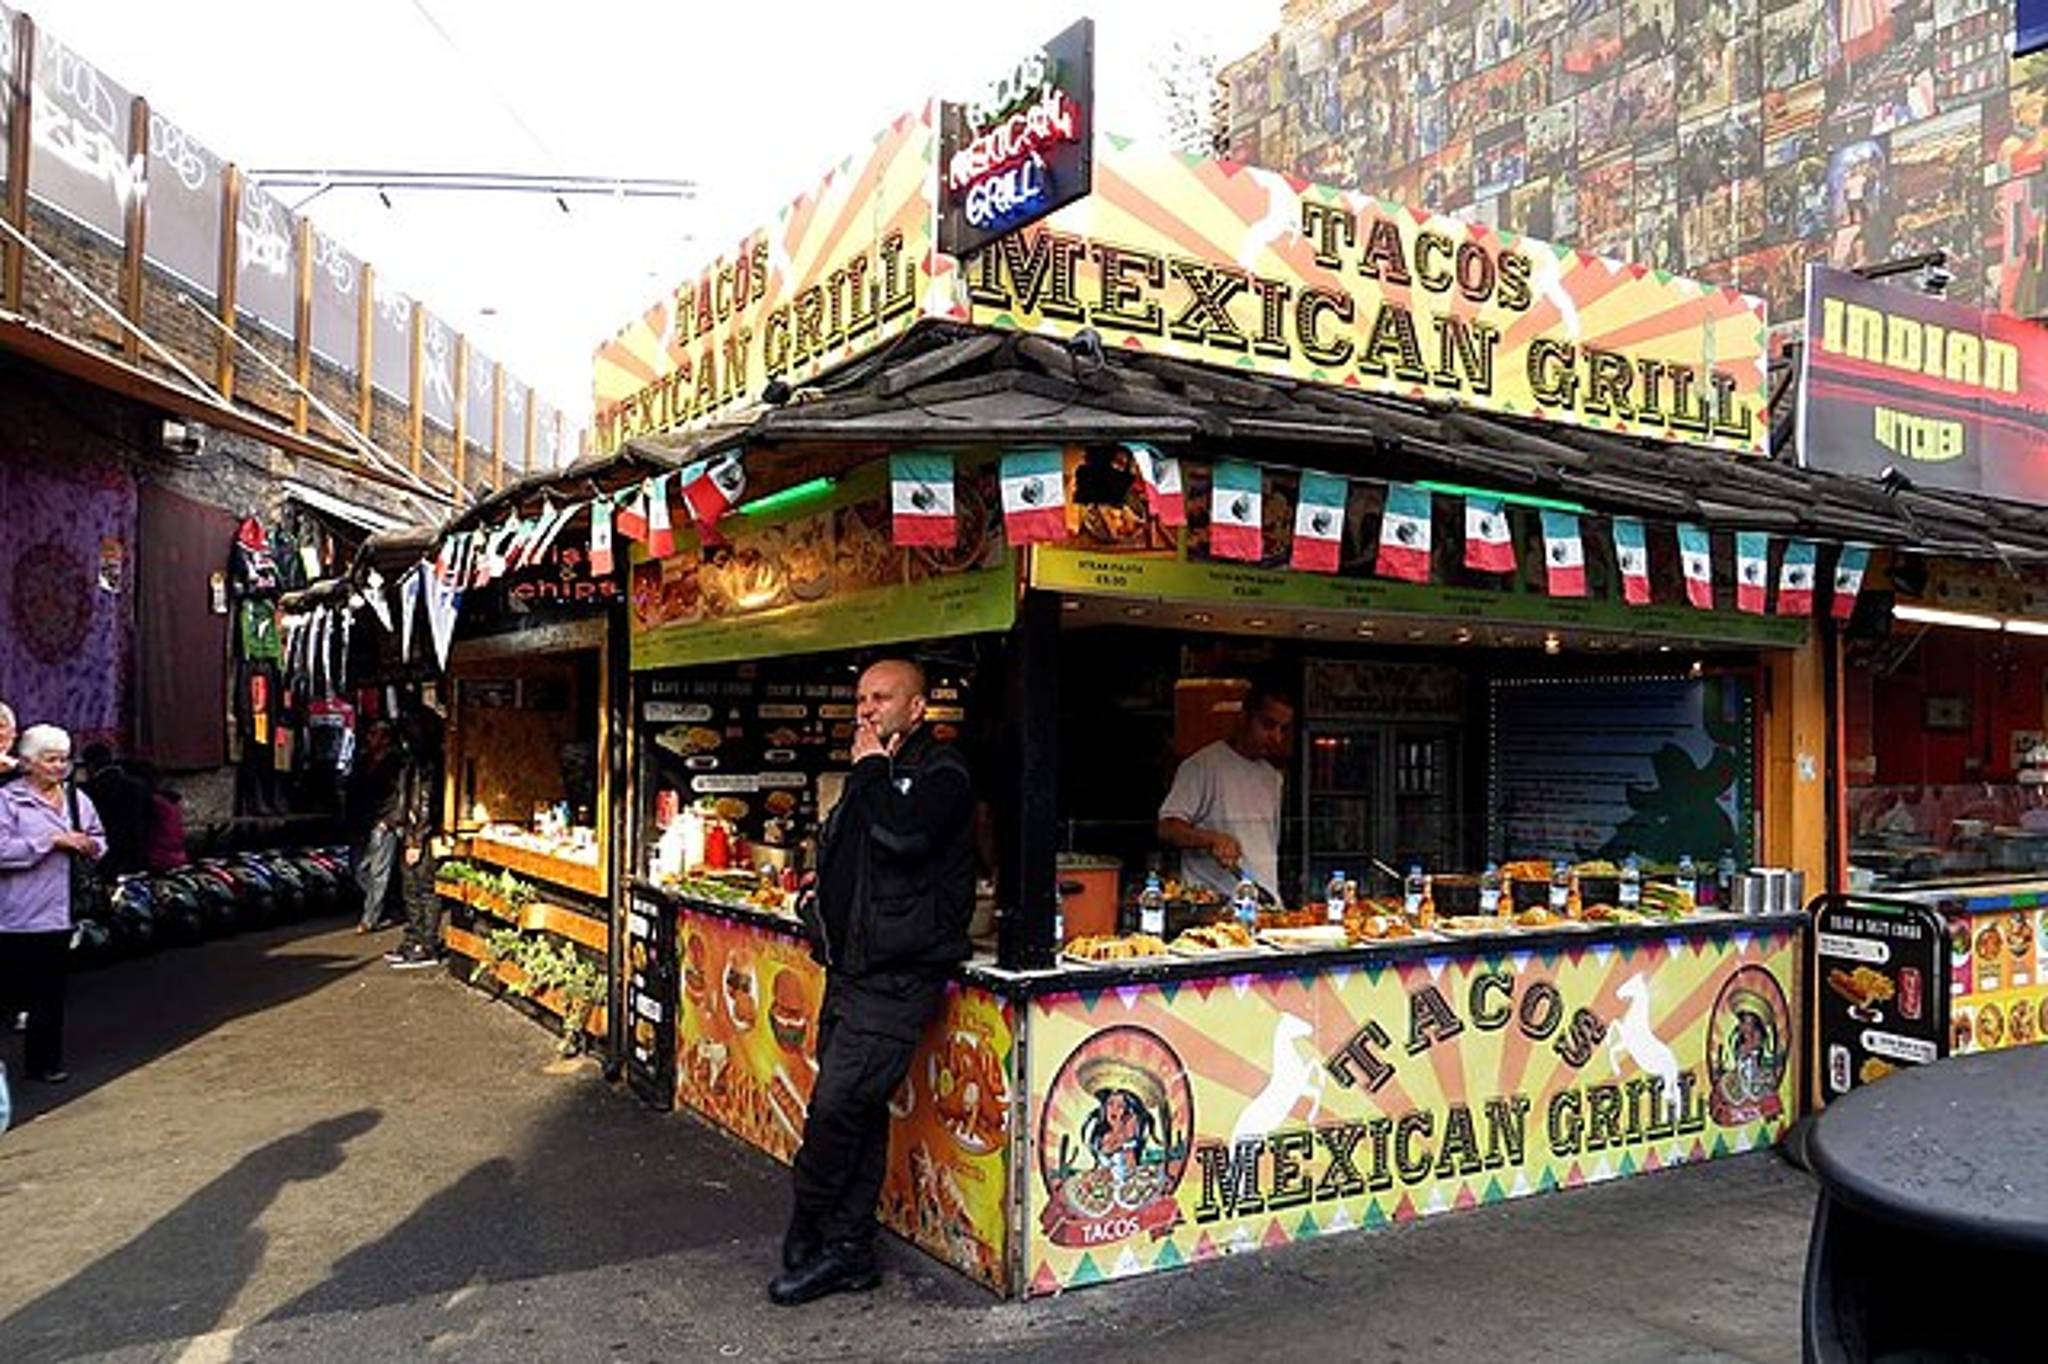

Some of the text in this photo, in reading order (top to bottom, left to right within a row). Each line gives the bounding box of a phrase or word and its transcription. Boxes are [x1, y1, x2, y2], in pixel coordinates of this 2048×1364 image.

[965, 158, 1043, 225] GRILL
[675, 238, 768, 347] TACOS
[1302, 202, 1531, 311] TACOS
[594, 228, 916, 455] MEXICAN GRILL
[970, 226, 1751, 439] MEXICAN GRILL
[1822, 298, 2018, 394] INDIAN
[1325, 971, 1607, 1094] TACOS
[1196, 1070, 1706, 1224] MEXICAN GRILL
[1081, 1217, 1141, 1244] TACOS
